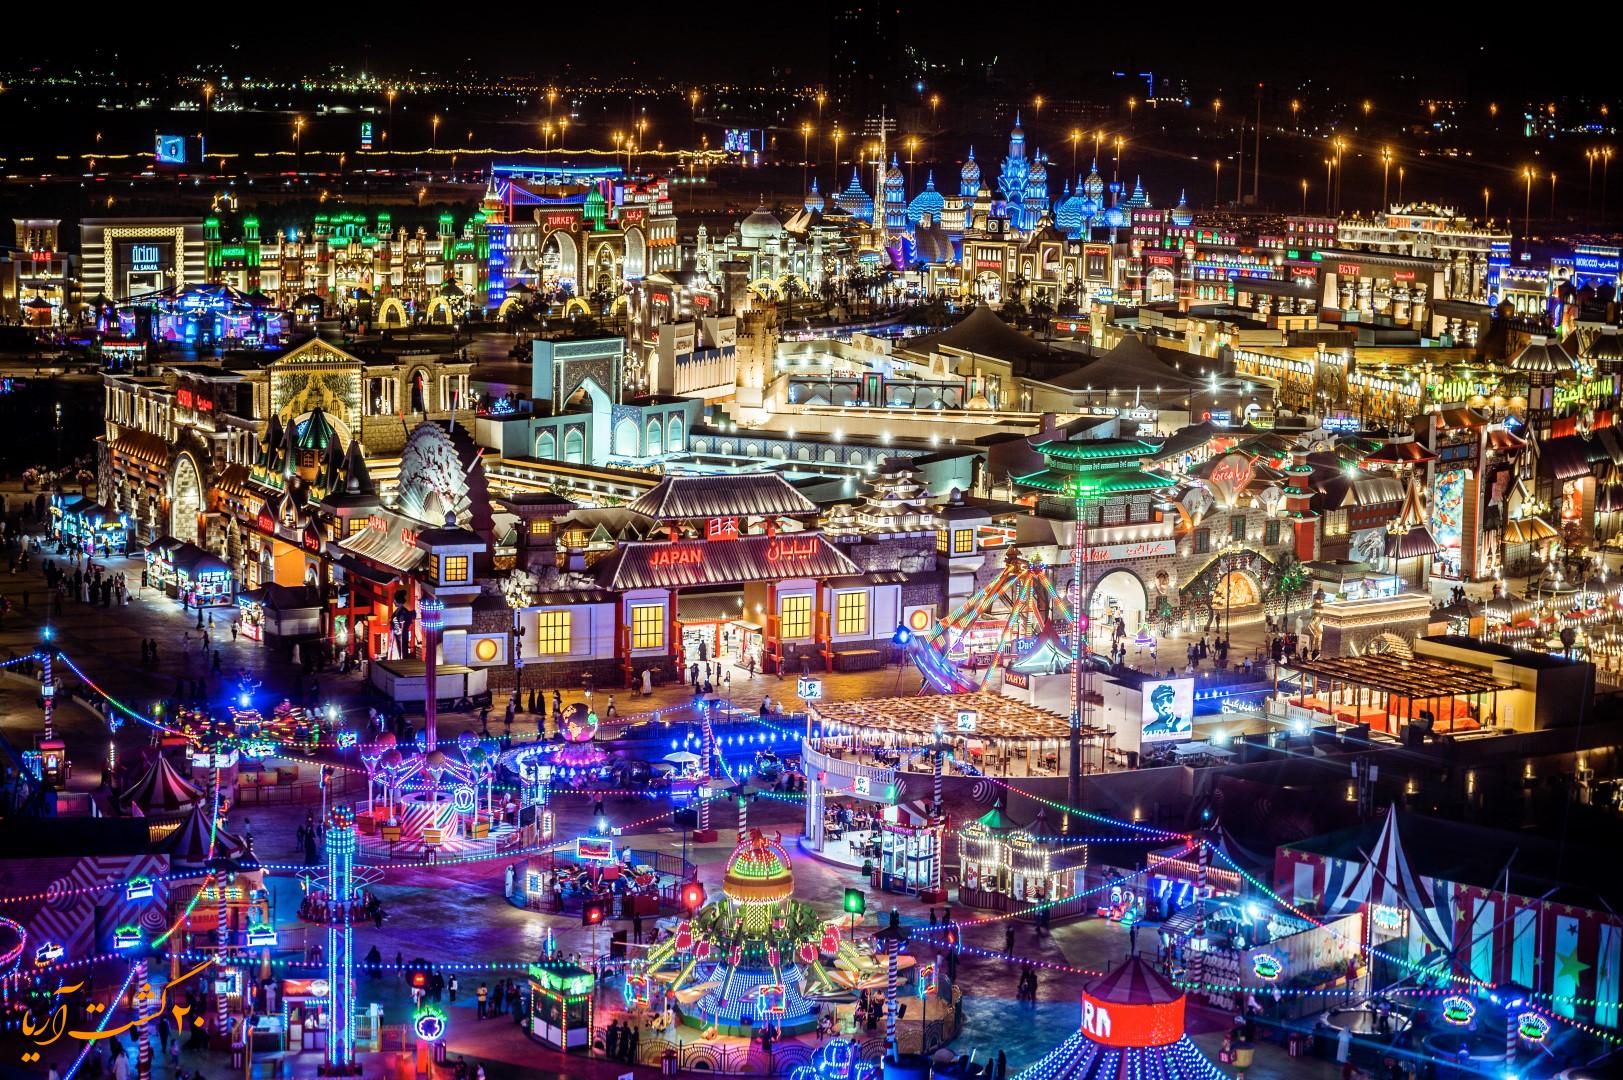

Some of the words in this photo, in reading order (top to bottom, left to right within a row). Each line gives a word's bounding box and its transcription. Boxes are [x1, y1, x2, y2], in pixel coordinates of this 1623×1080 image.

[548, 216, 574, 225] TURKEY
[32, 252, 52, 261] UAE
[1148, 255, 1173, 265] YEMEN
[1338, 264, 1360, 276] EGYPT
[1434, 380, 1475, 401] CHINA
[1585, 379, 1613, 399] CHINA
[1212, 471, 1234, 482] Korea
[368, 514, 387, 532] JAPAN
[709, 518, 737, 536] 日本
[768, 539, 818, 561] اليابان
[650, 550, 701, 565] JAPAN
[1005, 672, 1027, 686] YAHYA
[1143, 729, 1170, 737] YAHYA
